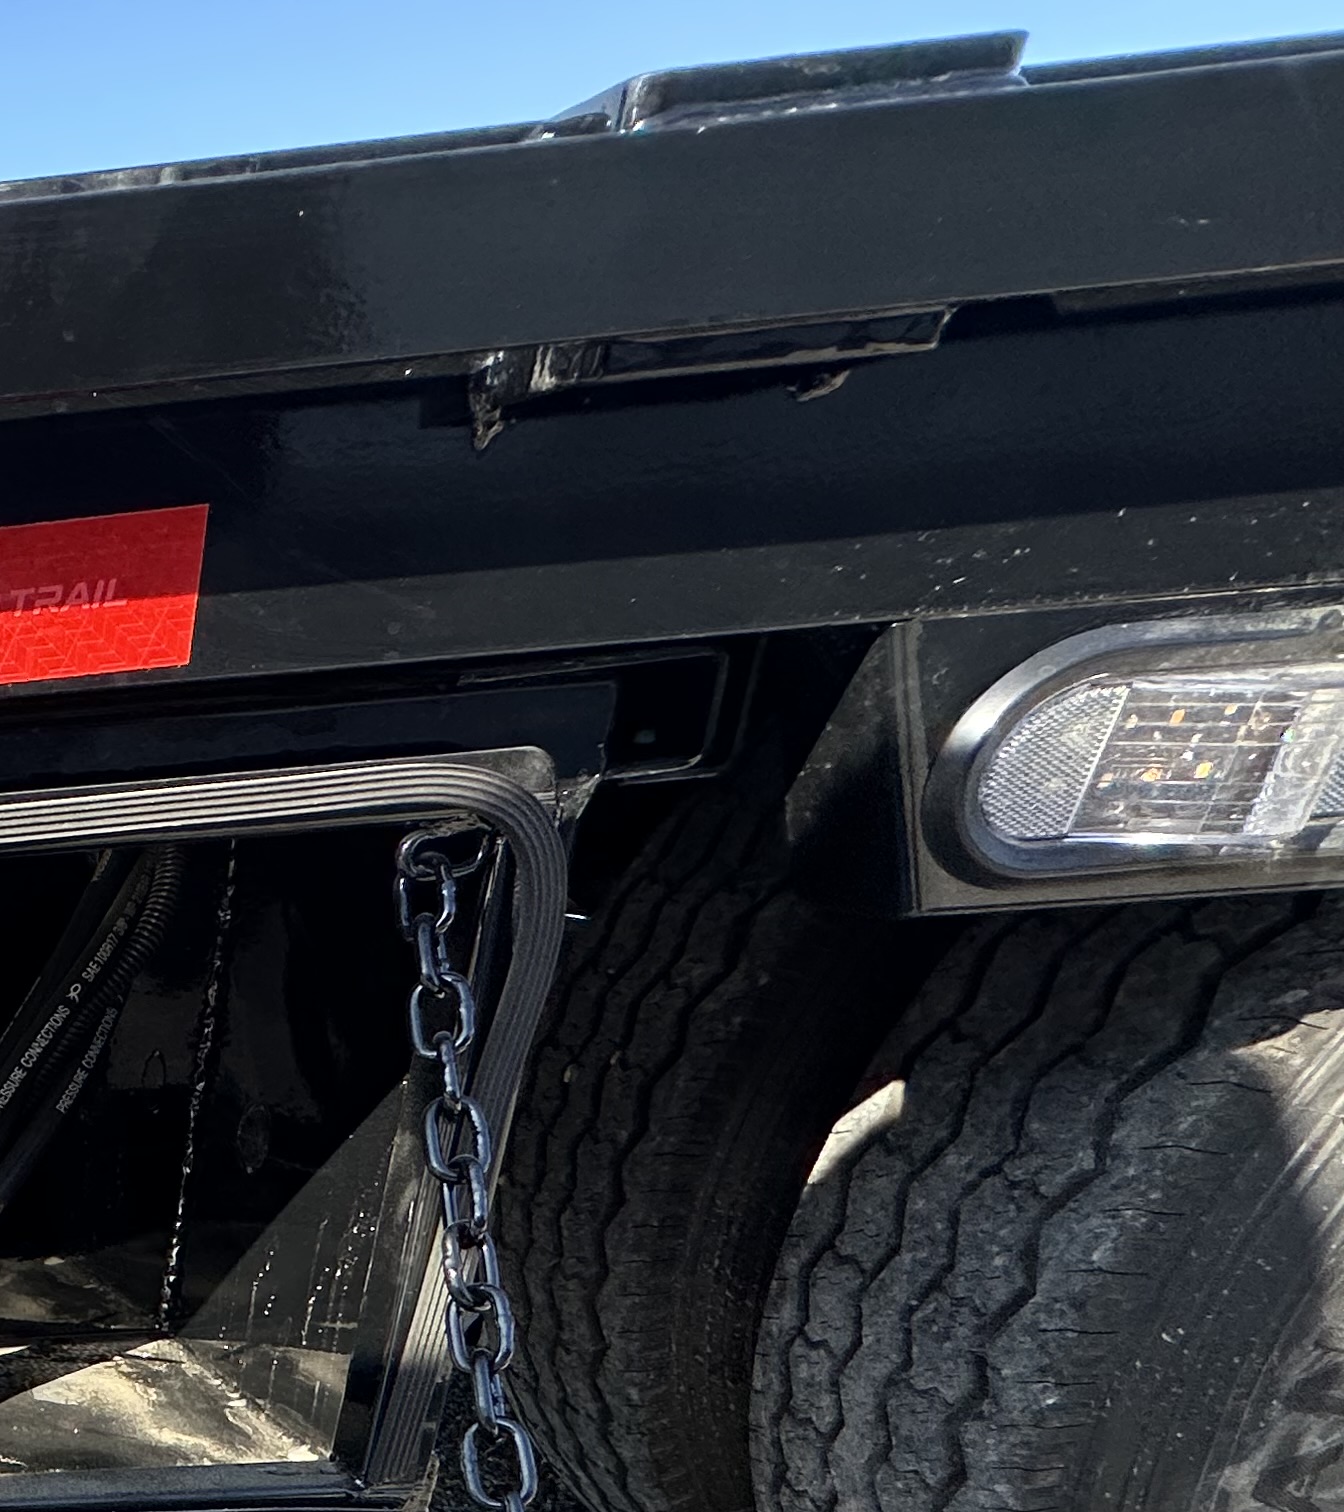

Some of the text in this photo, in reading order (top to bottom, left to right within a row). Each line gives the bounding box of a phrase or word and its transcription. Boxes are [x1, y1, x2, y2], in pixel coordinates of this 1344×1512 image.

[11, 578, 129, 617] TRAIL
[20, 1004, 71, 1067] CONNECTIONS
[55, 1006, 119, 1113] PRESSURE CONNECTIONS
